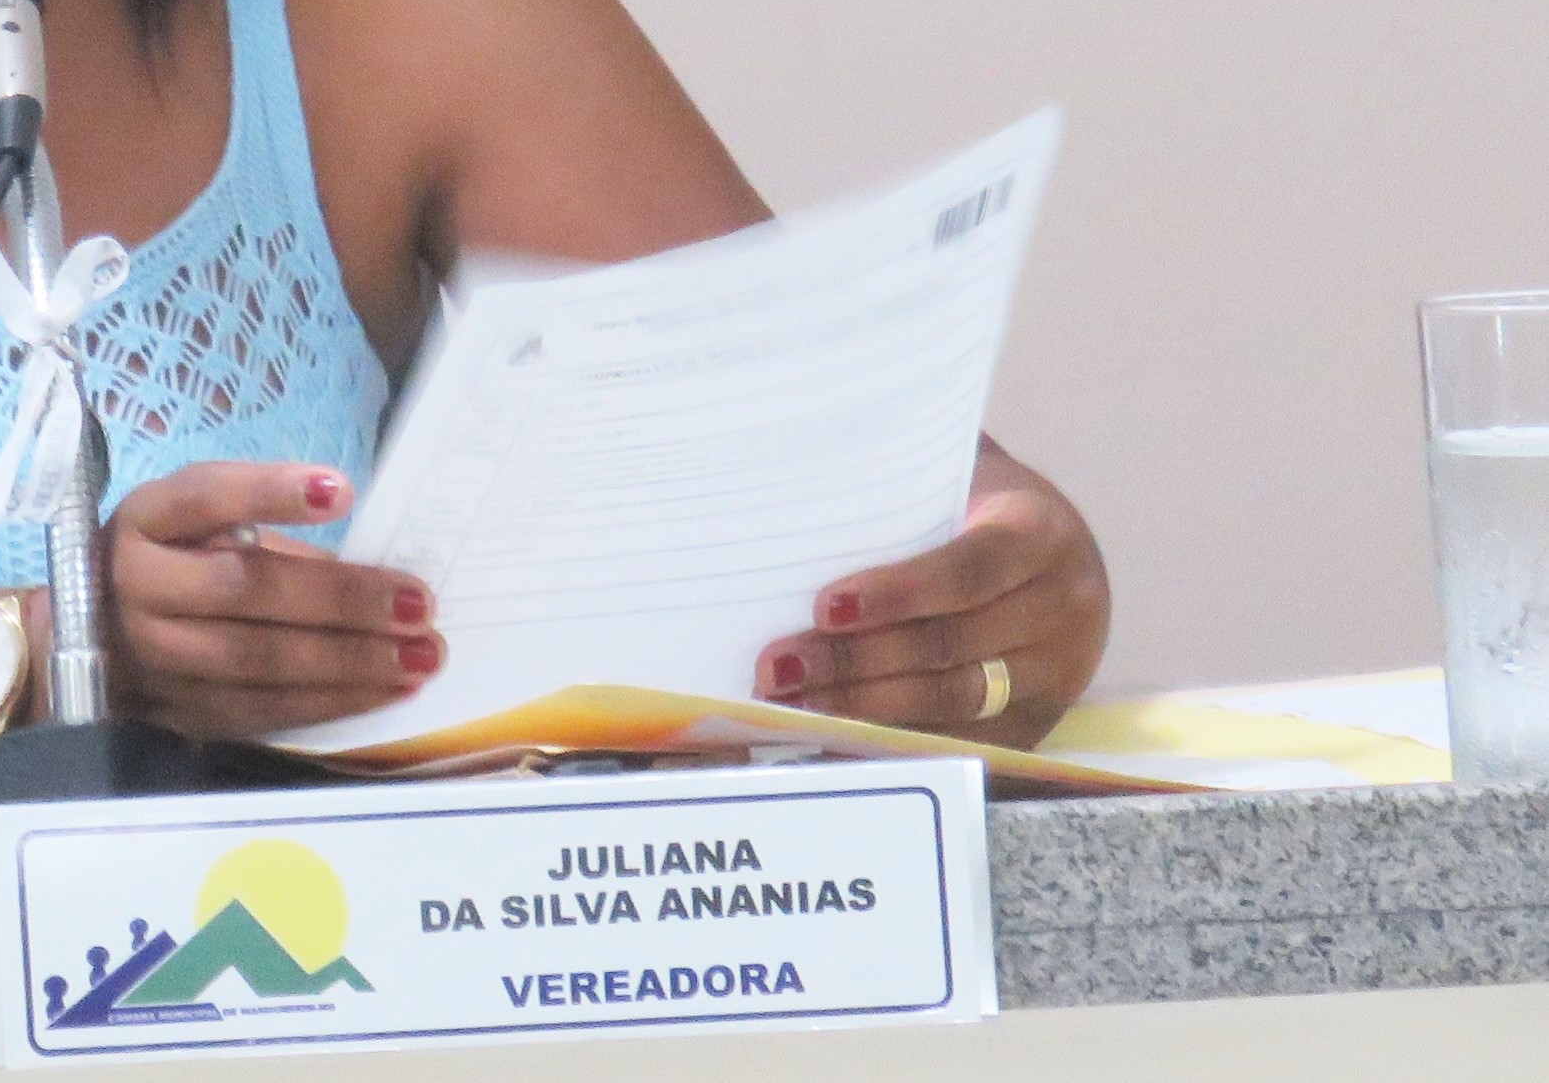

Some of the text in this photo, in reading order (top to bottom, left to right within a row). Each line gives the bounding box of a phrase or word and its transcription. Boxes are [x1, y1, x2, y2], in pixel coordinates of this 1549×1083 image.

[547, 838, 762, 881] JULIANA
[420, 878, 876, 933] DA SILVA ANANIAS
[501, 961, 805, 1008] VEREADORA
